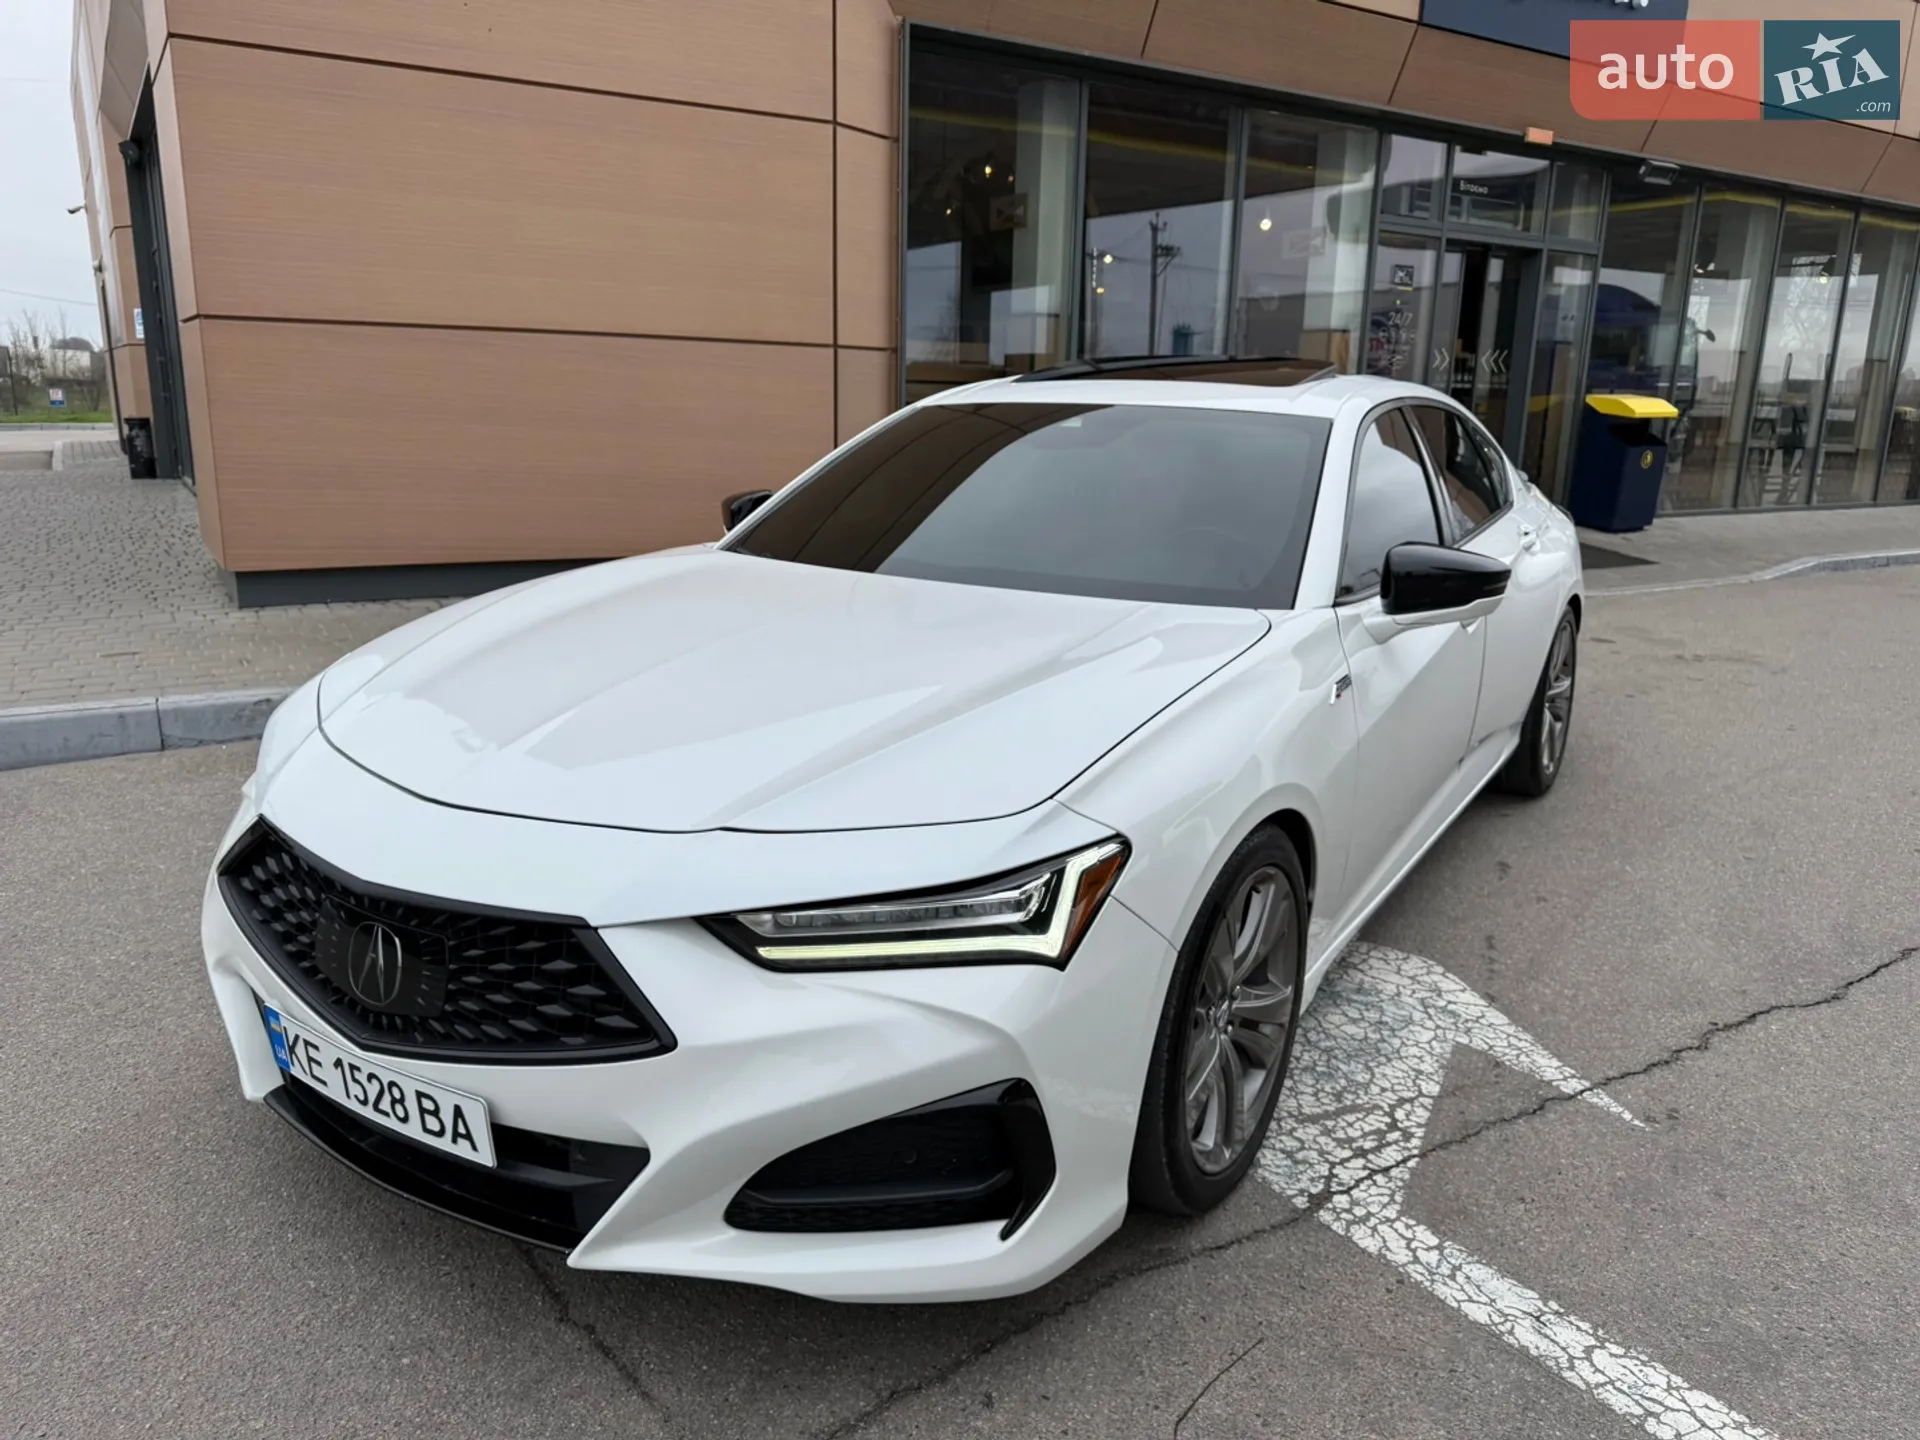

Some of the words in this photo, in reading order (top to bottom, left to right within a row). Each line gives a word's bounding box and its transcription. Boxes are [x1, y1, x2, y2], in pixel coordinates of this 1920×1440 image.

[1388, 311, 1413, 326] 24/7
[282, 1025, 329, 1089] KE
[333, 1056, 409, 1125] 1528
[414, 1088, 480, 1154] BA
